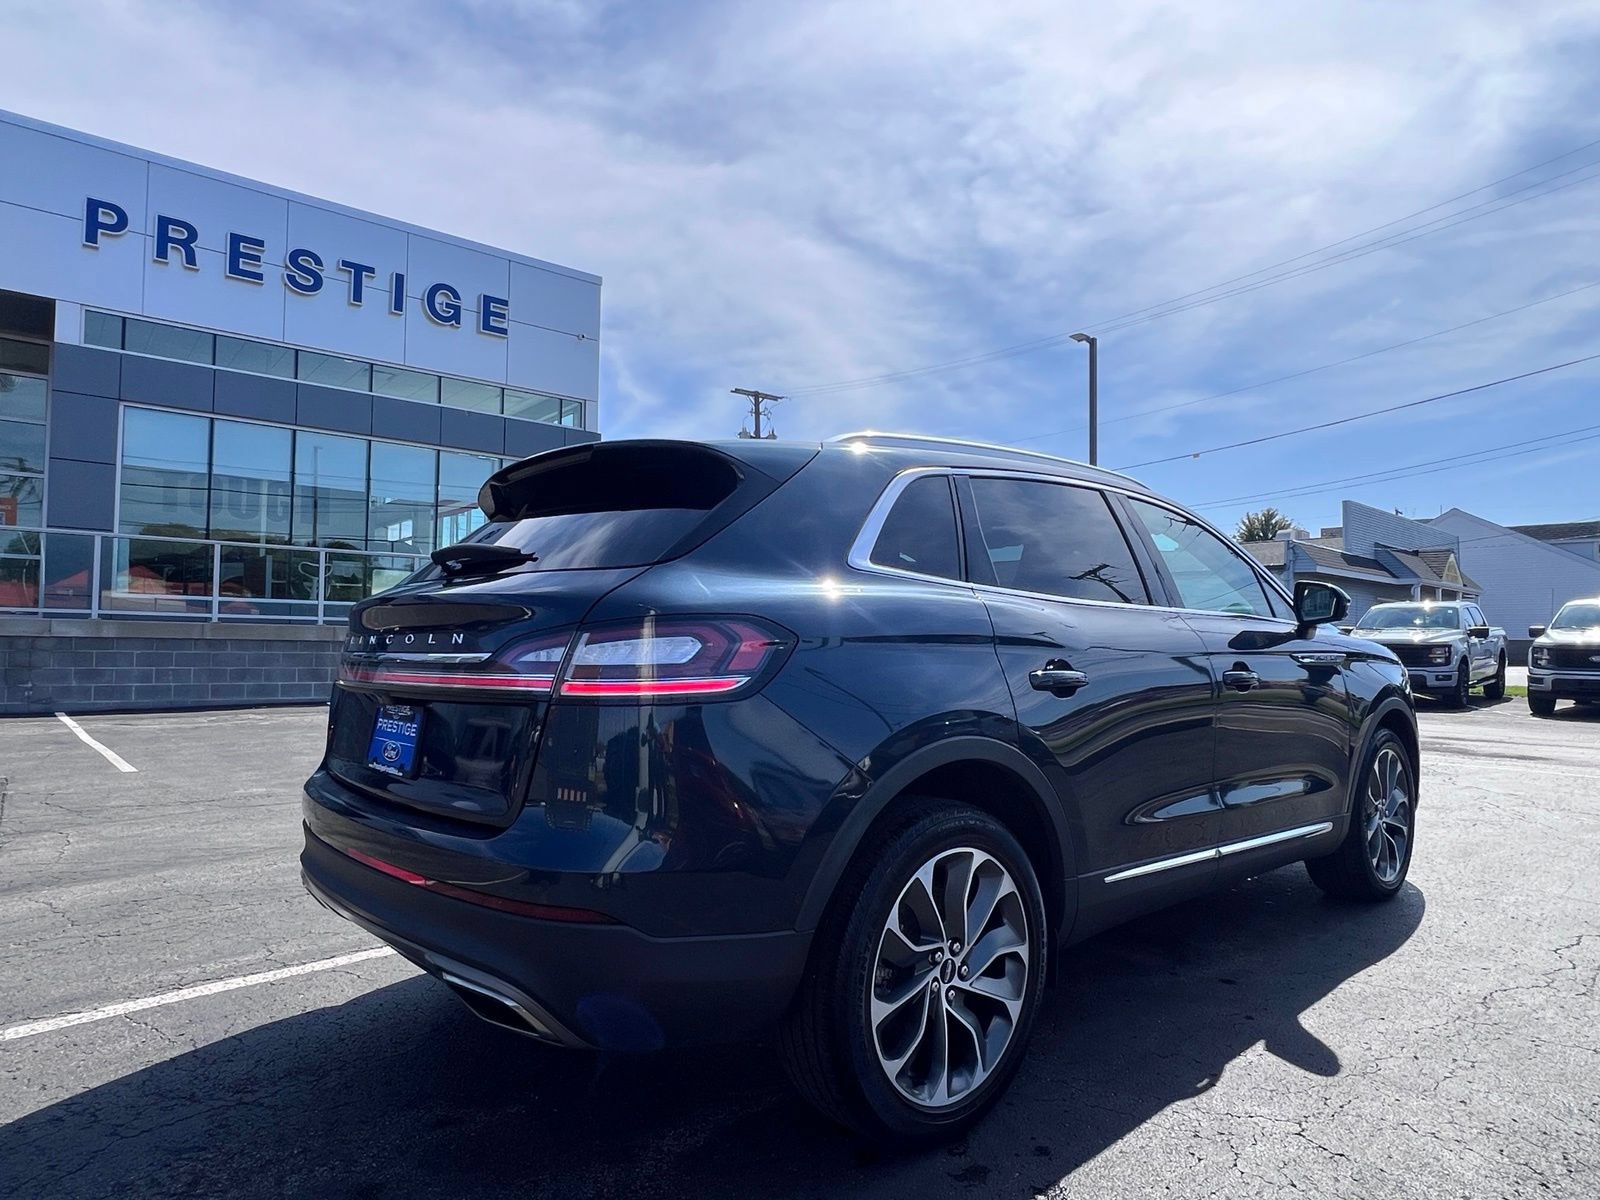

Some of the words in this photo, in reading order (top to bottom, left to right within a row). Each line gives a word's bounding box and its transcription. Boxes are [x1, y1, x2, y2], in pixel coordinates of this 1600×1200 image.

[82, 197, 510, 337] PRESTIGE
[350, 633, 464, 645] LINCOLN
[376, 718, 418, 737] PRESTIGE
